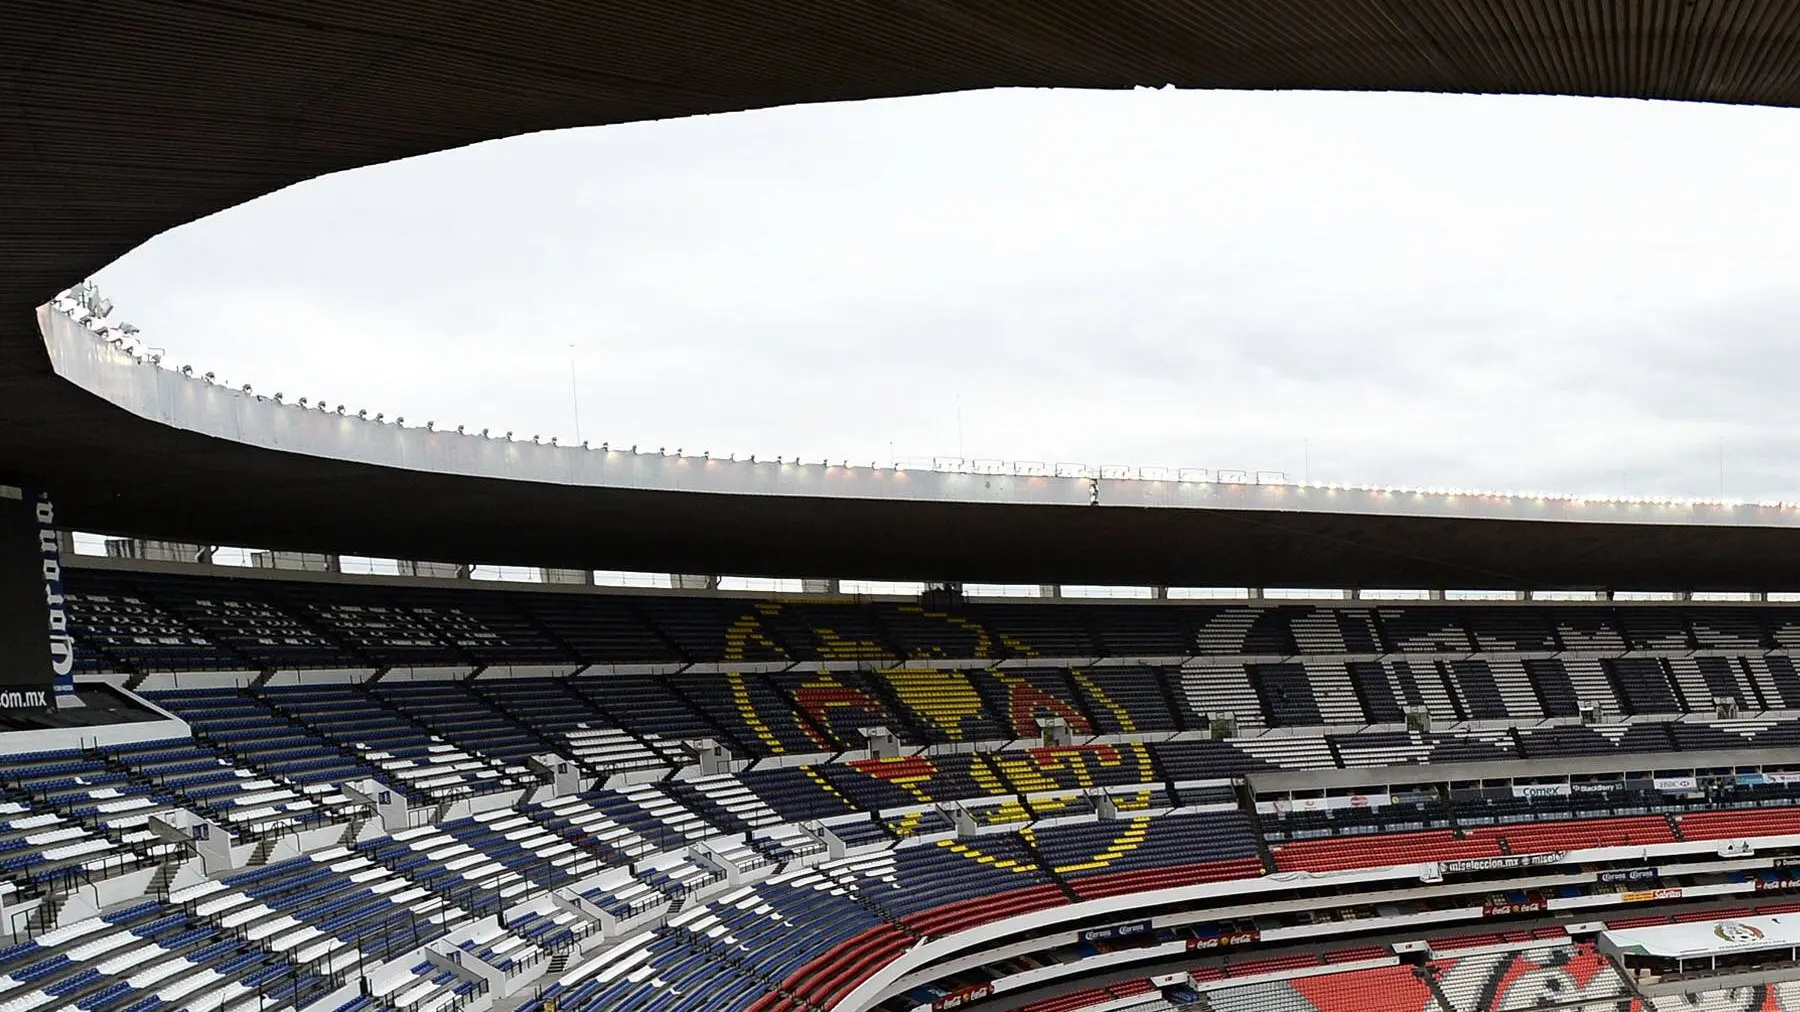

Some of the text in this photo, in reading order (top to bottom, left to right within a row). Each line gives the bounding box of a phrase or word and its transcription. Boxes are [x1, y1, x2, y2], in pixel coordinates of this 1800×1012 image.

[36, 500, 74, 675] Corona
[0, 690, 47, 708] om.mx
[1449, 857, 1519, 873] miseleccion.mx
